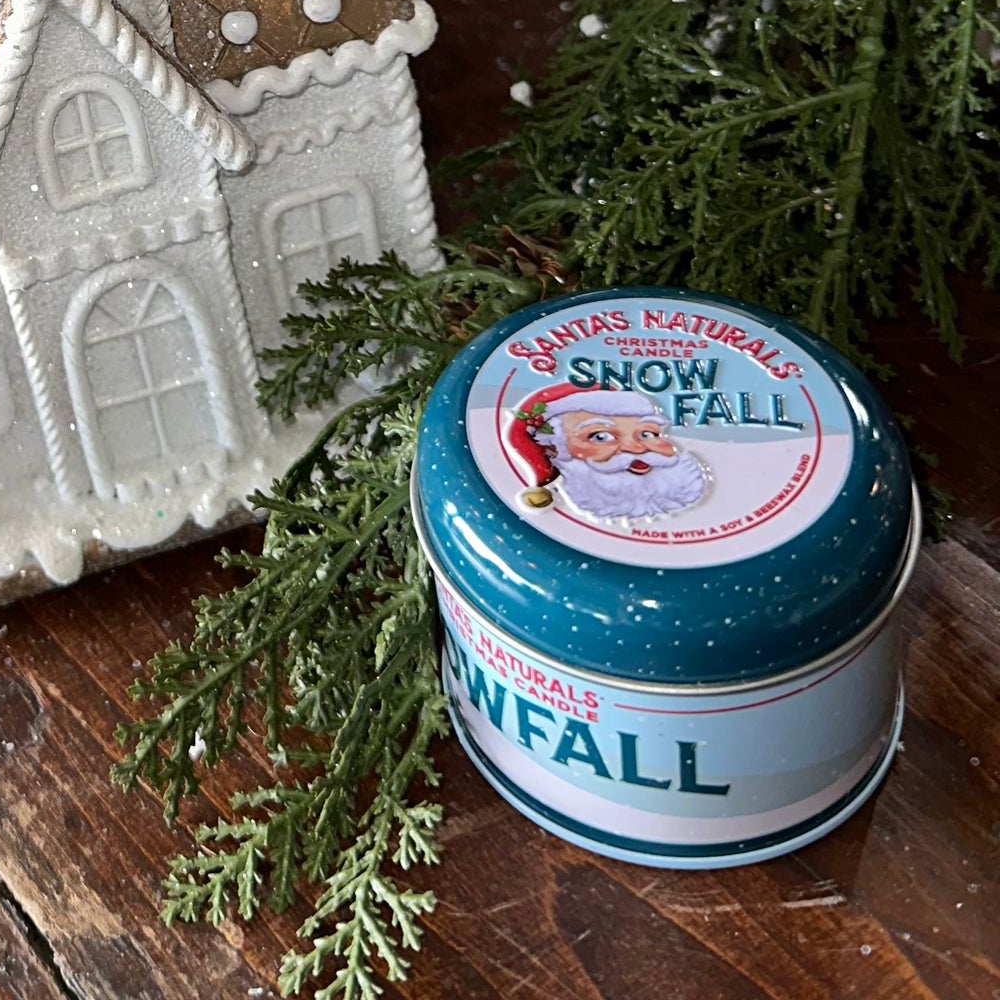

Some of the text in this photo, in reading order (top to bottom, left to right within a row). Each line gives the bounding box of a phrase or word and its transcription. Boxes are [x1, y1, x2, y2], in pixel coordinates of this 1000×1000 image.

[506, 309, 801, 380] SANTA'S NATURALS
[604, 336, 709, 349] CHRISTMAS
[619, 346, 694, 358] CANDLE
[567, 357, 720, 393] SNOW
[670, 391, 804, 431] FALL
[631, 528, 668, 539] MADE
[671, 529, 707, 540] WITH
[709, 526, 719, 536] A
[720, 518, 742, 532] SOY
[744, 514, 755, 523] &
[790, 453, 811, 483] BLEND
[480, 630, 600, 709] NATURALS
[514, 678, 600, 724] CANDLE
